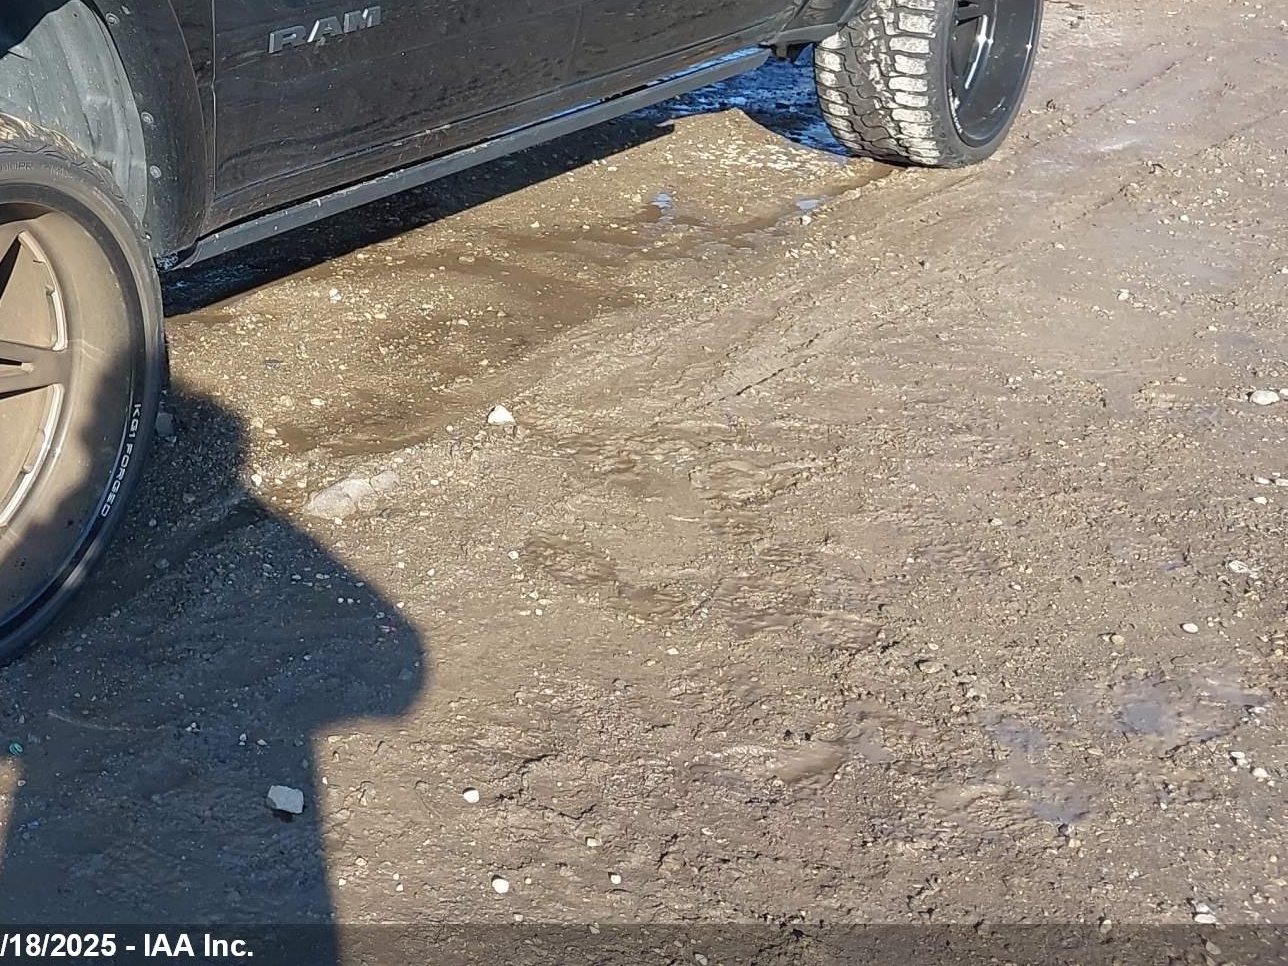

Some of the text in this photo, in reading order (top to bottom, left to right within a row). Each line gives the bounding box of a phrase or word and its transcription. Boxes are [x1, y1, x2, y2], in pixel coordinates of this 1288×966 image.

[268, 5, 382, 54] RAM
[100, 403, 142, 518] KG1 FORGED
